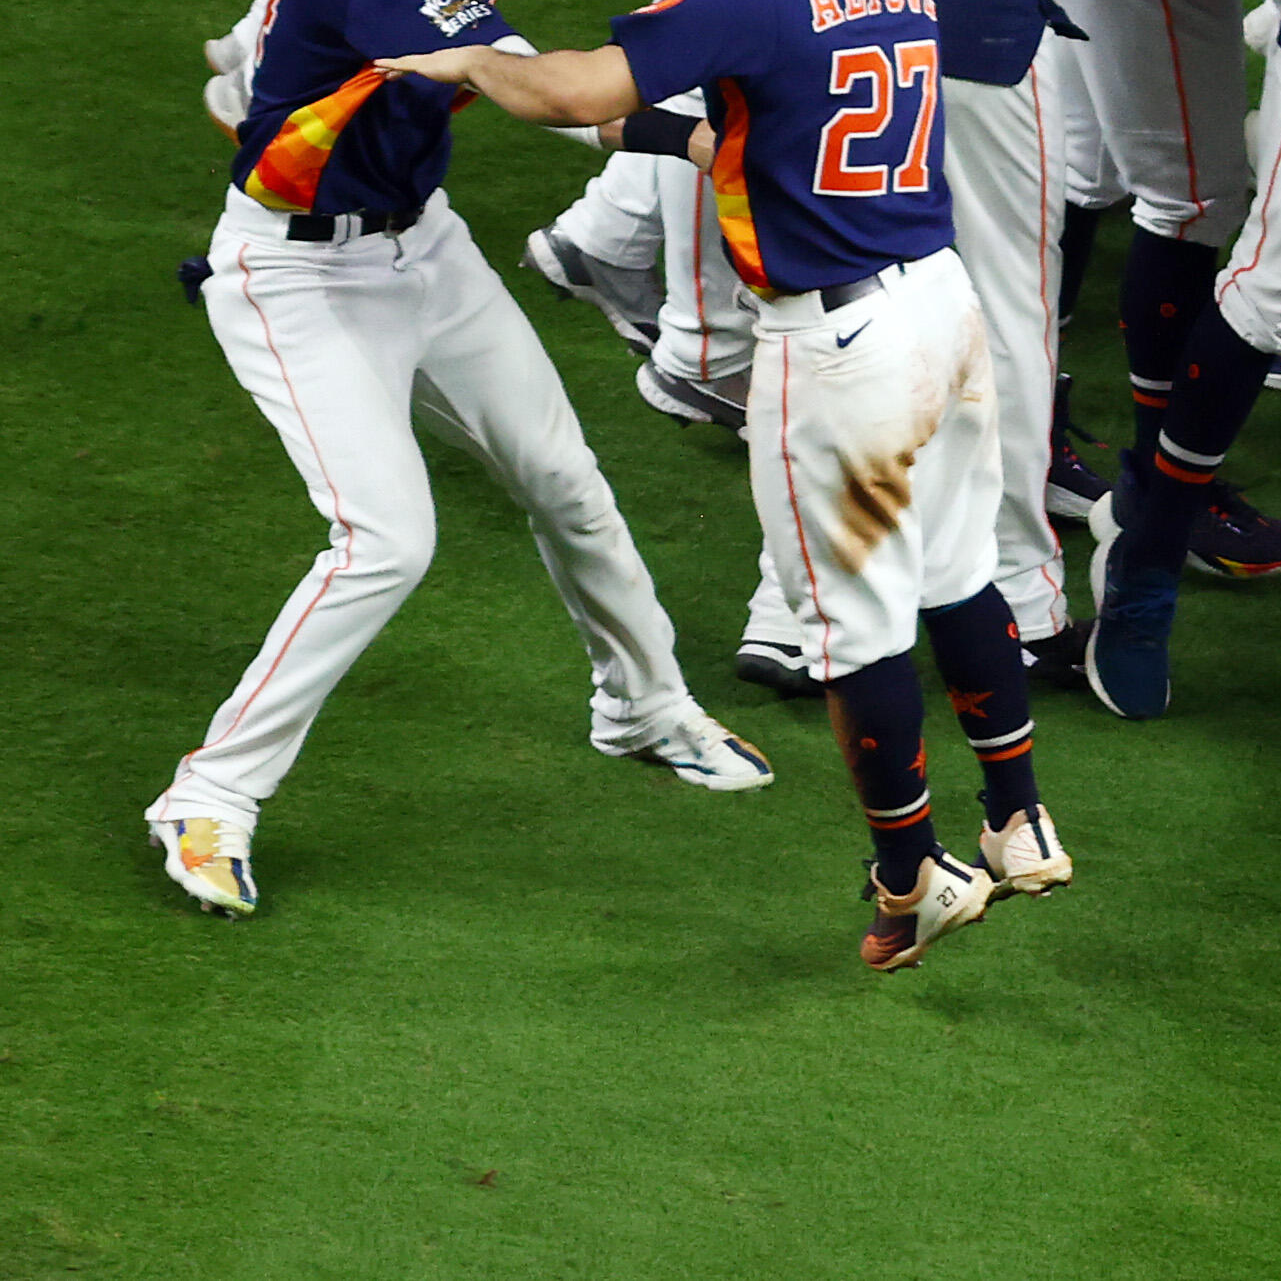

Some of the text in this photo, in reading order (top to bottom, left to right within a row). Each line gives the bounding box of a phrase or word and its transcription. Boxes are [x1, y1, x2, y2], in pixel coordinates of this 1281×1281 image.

[440, 3, 493, 37] SERIES
[812, 39, 938, 197] 27
[935, 885, 957, 908] 27
